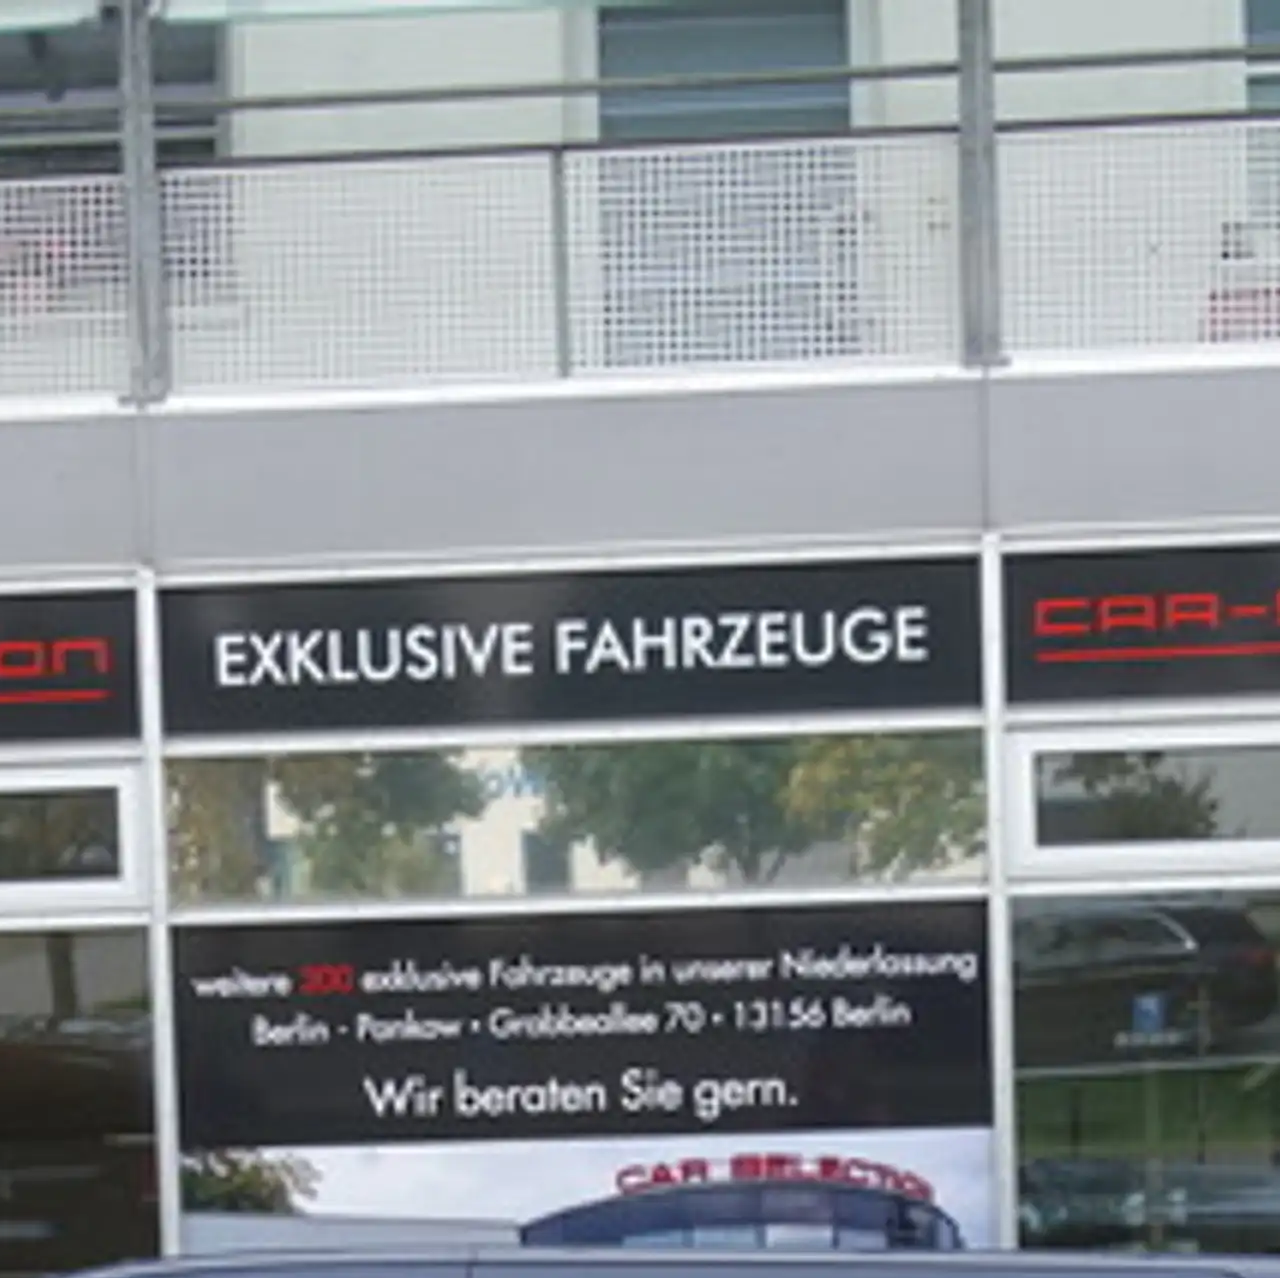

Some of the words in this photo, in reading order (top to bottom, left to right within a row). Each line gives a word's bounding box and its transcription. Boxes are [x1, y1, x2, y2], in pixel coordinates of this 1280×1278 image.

[215, 623, 533, 685] EXKLUSIVE
[556, 607, 927, 673] FAHRZEUGE
[191, 966, 291, 997] weitere
[361, 958, 482, 992] exklusive
[490, 953, 632, 993] Fahrzeuge
[640, 955, 665, 982] in
[672, 960, 773, 983] unserer
[780, 945, 977, 982] Niederlassung
[253, 1010, 329, 1045] Berlin
[357, 1009, 462, 1042] Pankow
[489, 1002, 658, 1038] Grabbeallee
[665, 1002, 705, 1033] 70
[735, 998, 826, 1030] 13156
[832, 992, 911, 1027] Berlin
[364, 1074, 443, 1116] Wir
[455, 1066, 606, 1116] beraten
[621, 1066, 683, 1111] Sie
[693, 1078, 797, 1121] gern.
